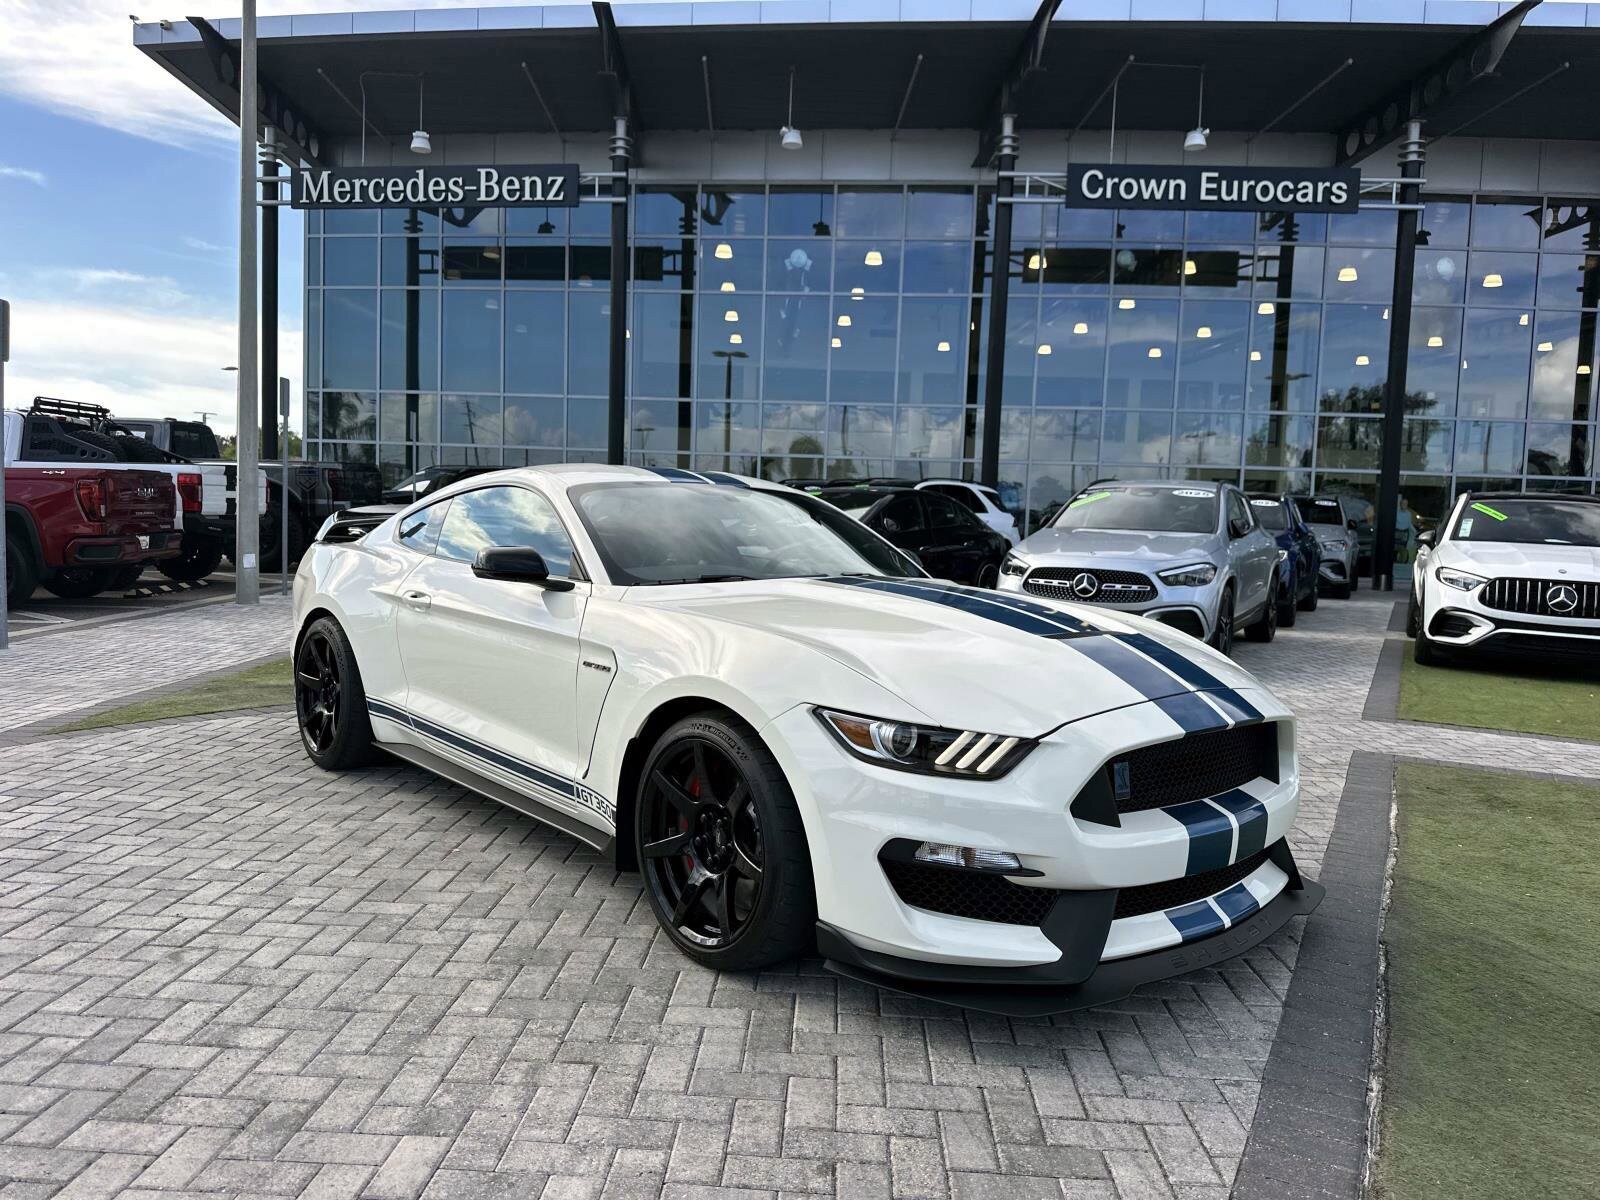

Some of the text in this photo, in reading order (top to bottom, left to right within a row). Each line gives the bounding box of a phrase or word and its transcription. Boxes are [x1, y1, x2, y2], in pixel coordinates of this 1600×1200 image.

[300, 167, 565, 203] Mercedes-Benz
[1081, 169, 1348, 205] Crown Eurocars
